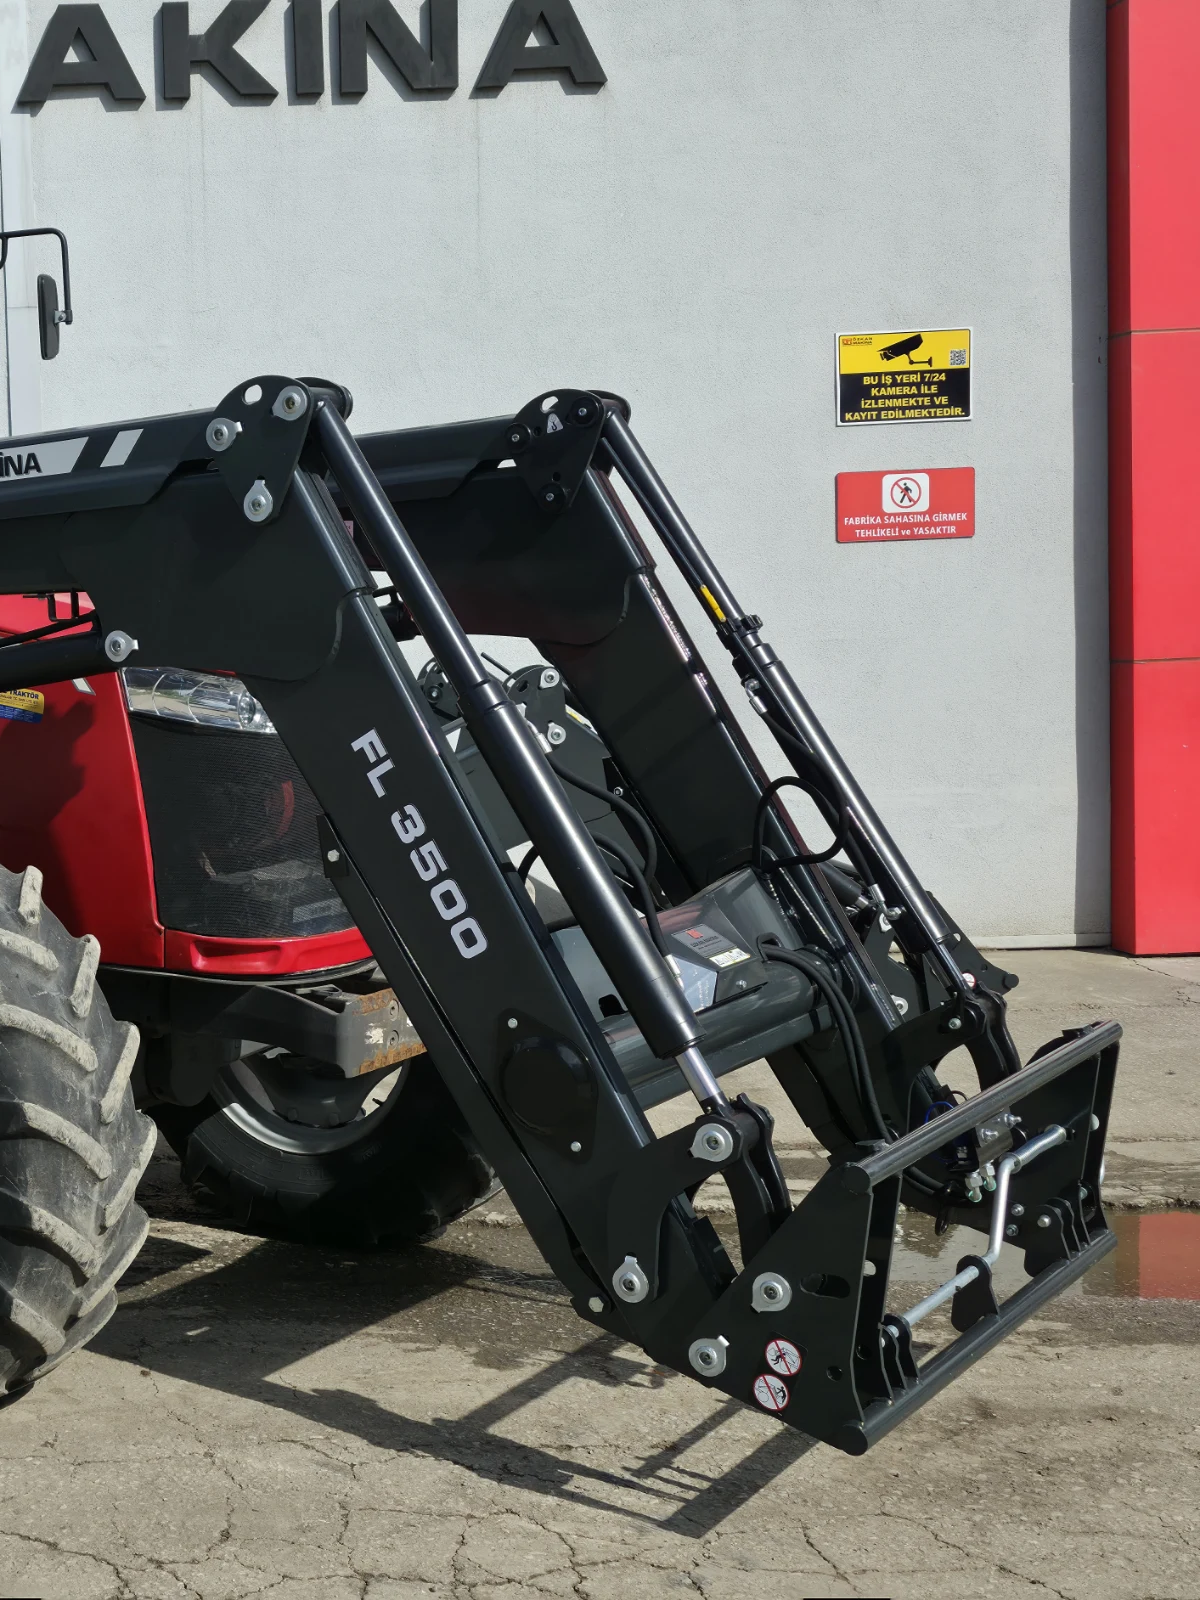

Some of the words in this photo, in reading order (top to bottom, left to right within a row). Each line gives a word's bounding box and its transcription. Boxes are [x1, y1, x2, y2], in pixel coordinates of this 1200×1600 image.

[863, 375, 879, 385] BU
[881, 374, 892, 386] İŞ
[895, 372, 921, 383] YERİ
[923, 372, 946, 382] 7/24
[871, 386, 918, 397] KAMERA
[920, 384, 938, 394] İLE
[861, 397, 931, 409] İZLENMEKTE
[934, 396, 949, 405] VE
[845, 411, 878, 421] KAYIT
[881, 405, 965, 420] EDİLMEKTEDİR.
[844, 514, 882, 526] FABRİKA
[883, 514, 931, 524] SAHASINA
[932, 511, 968, 523] GİRMEK
[855, 526, 899, 538] TEHLİKELİ
[913, 525, 956, 535] YASAKTIR
[350, 727, 395, 798] FL
[390, 803, 488, 959] 3500
